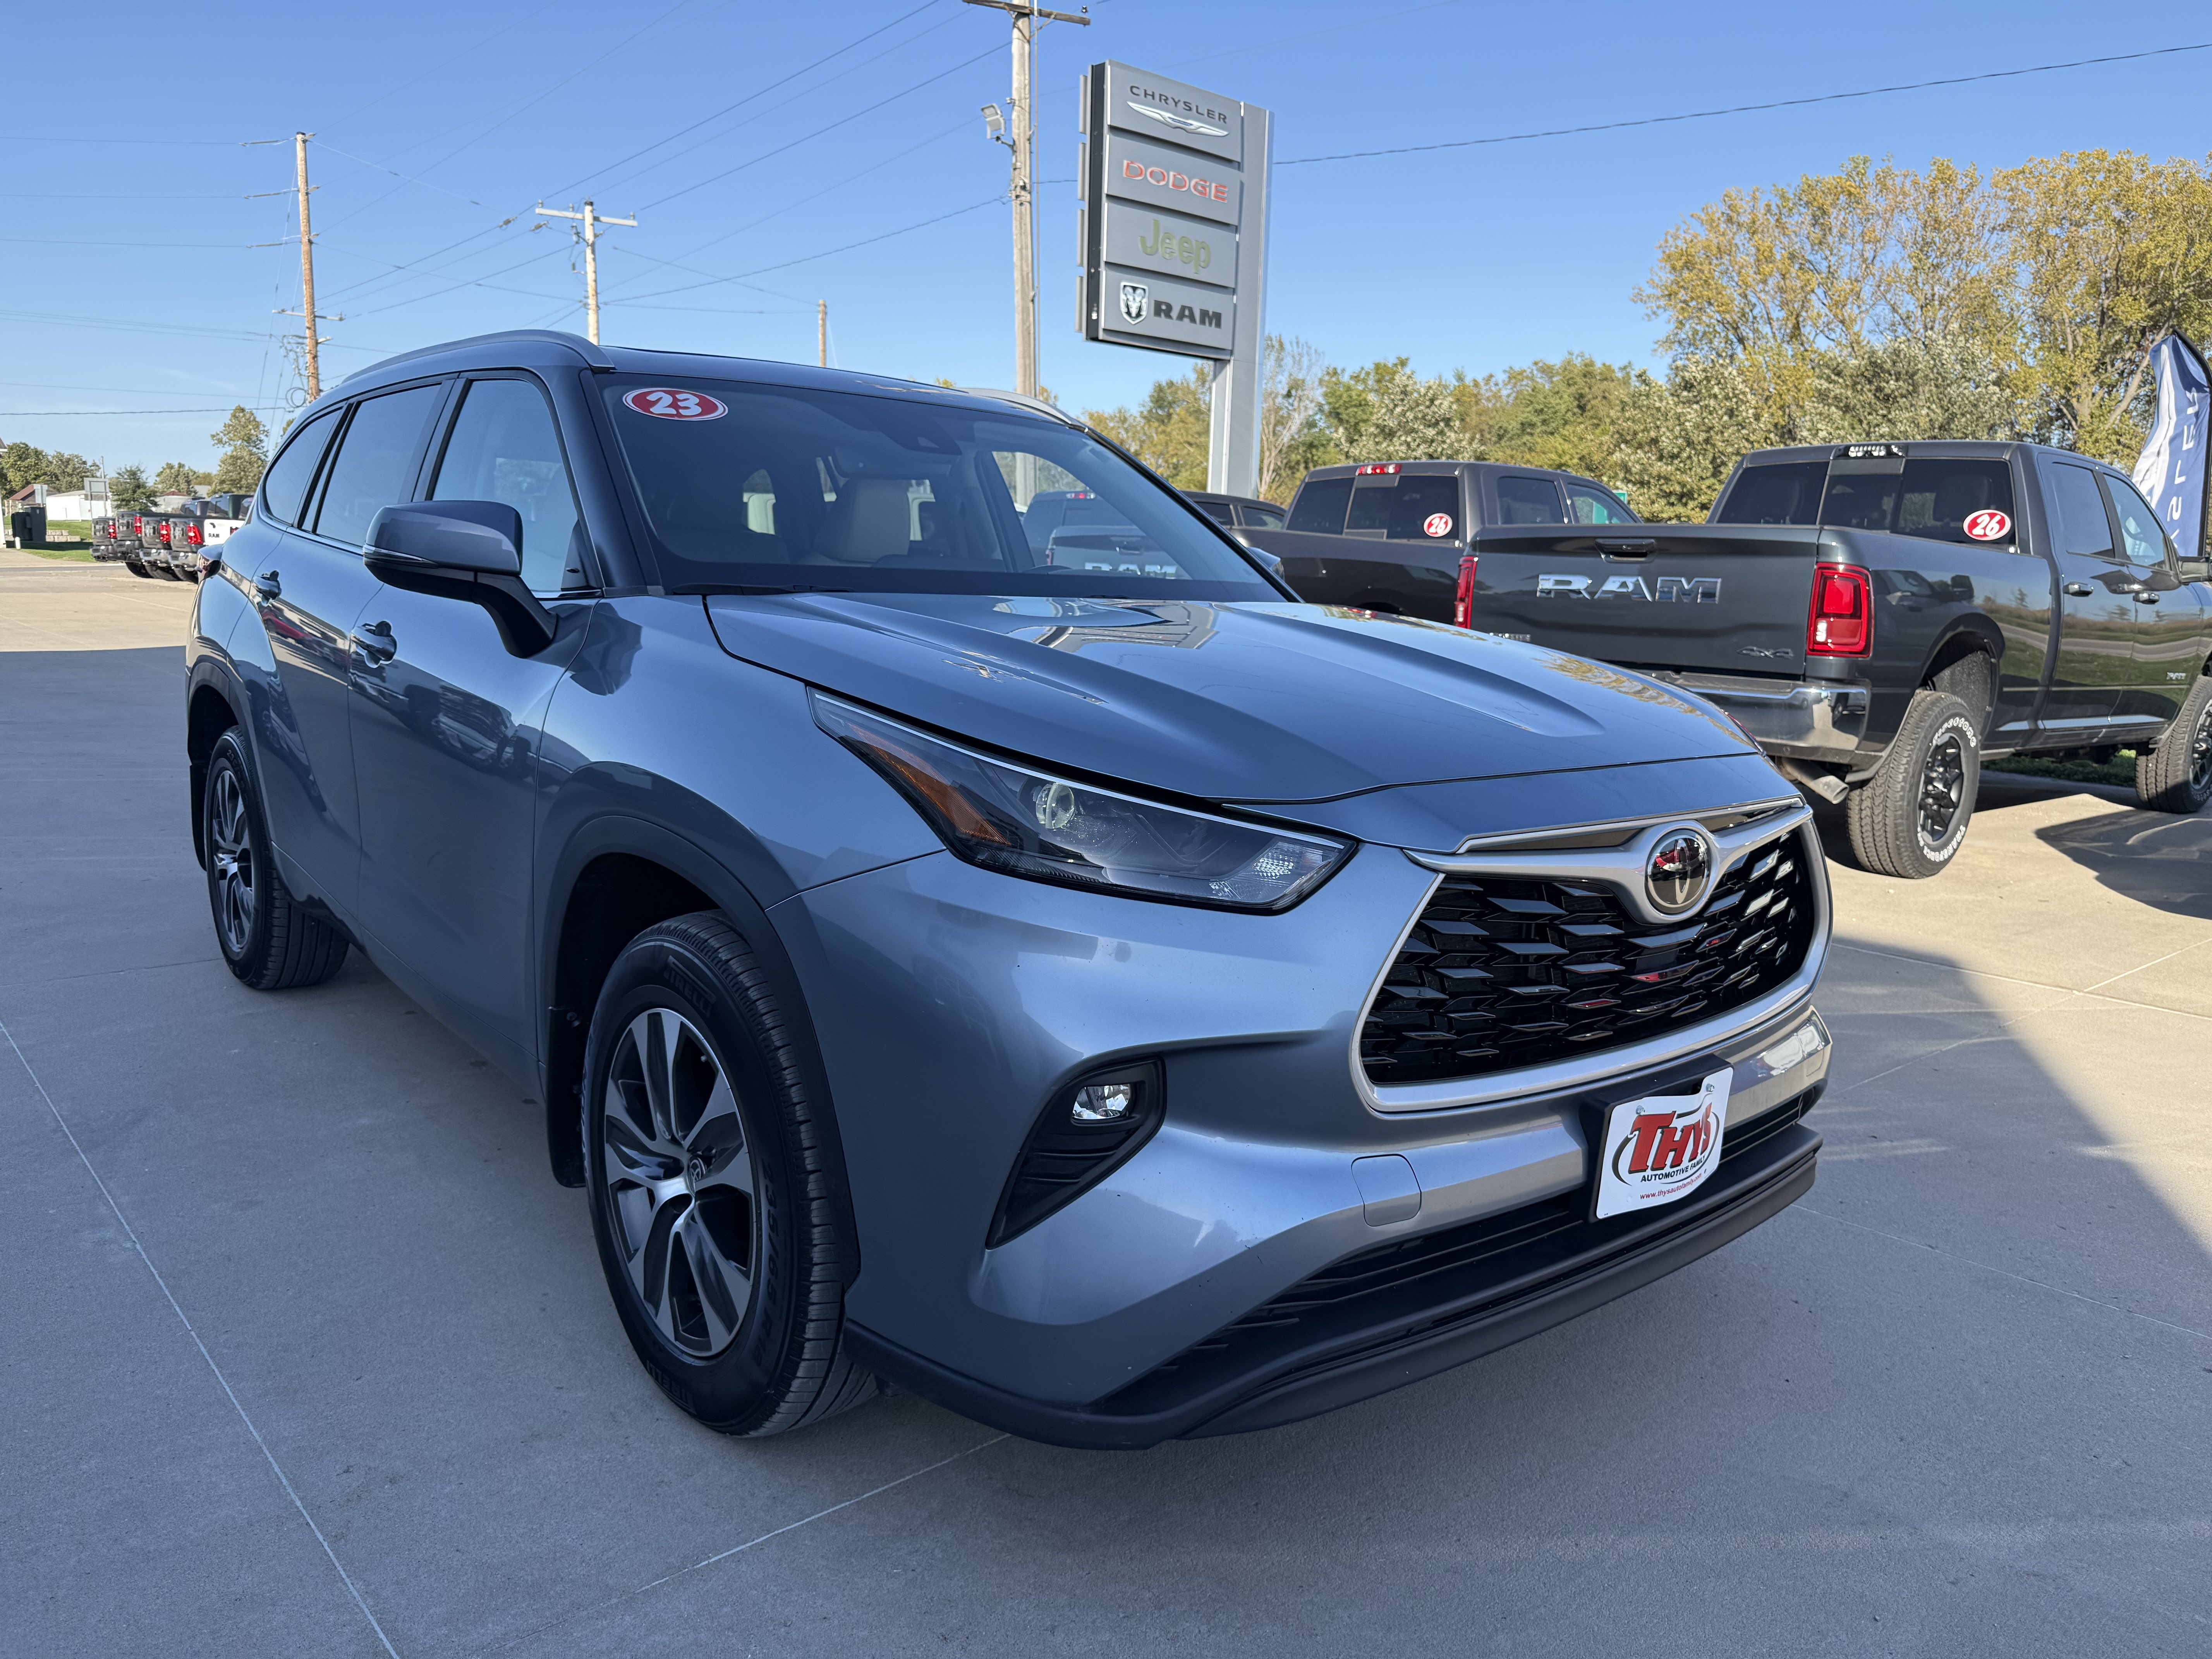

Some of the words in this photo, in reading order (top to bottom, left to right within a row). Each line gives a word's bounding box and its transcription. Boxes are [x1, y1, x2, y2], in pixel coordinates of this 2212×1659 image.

[1129, 85, 1228, 124] CHRYSLER
[1123, 160, 1228, 204] DODGE
[1138, 219, 1211, 274] Jeep
[1153, 299, 1223, 330] RAM
[646, 392, 702, 416] 23
[1429, 517, 1447, 534] 26
[1972, 514, 2001, 536] 26
[1537, 574, 1723, 604] RAM
[1640, 1165, 1689, 1183] AUTOMOTIVE
[1690, 1154, 1705, 1171] FAMILY
[1640, 1172, 1702, 1200] www.thysautofamily.com
